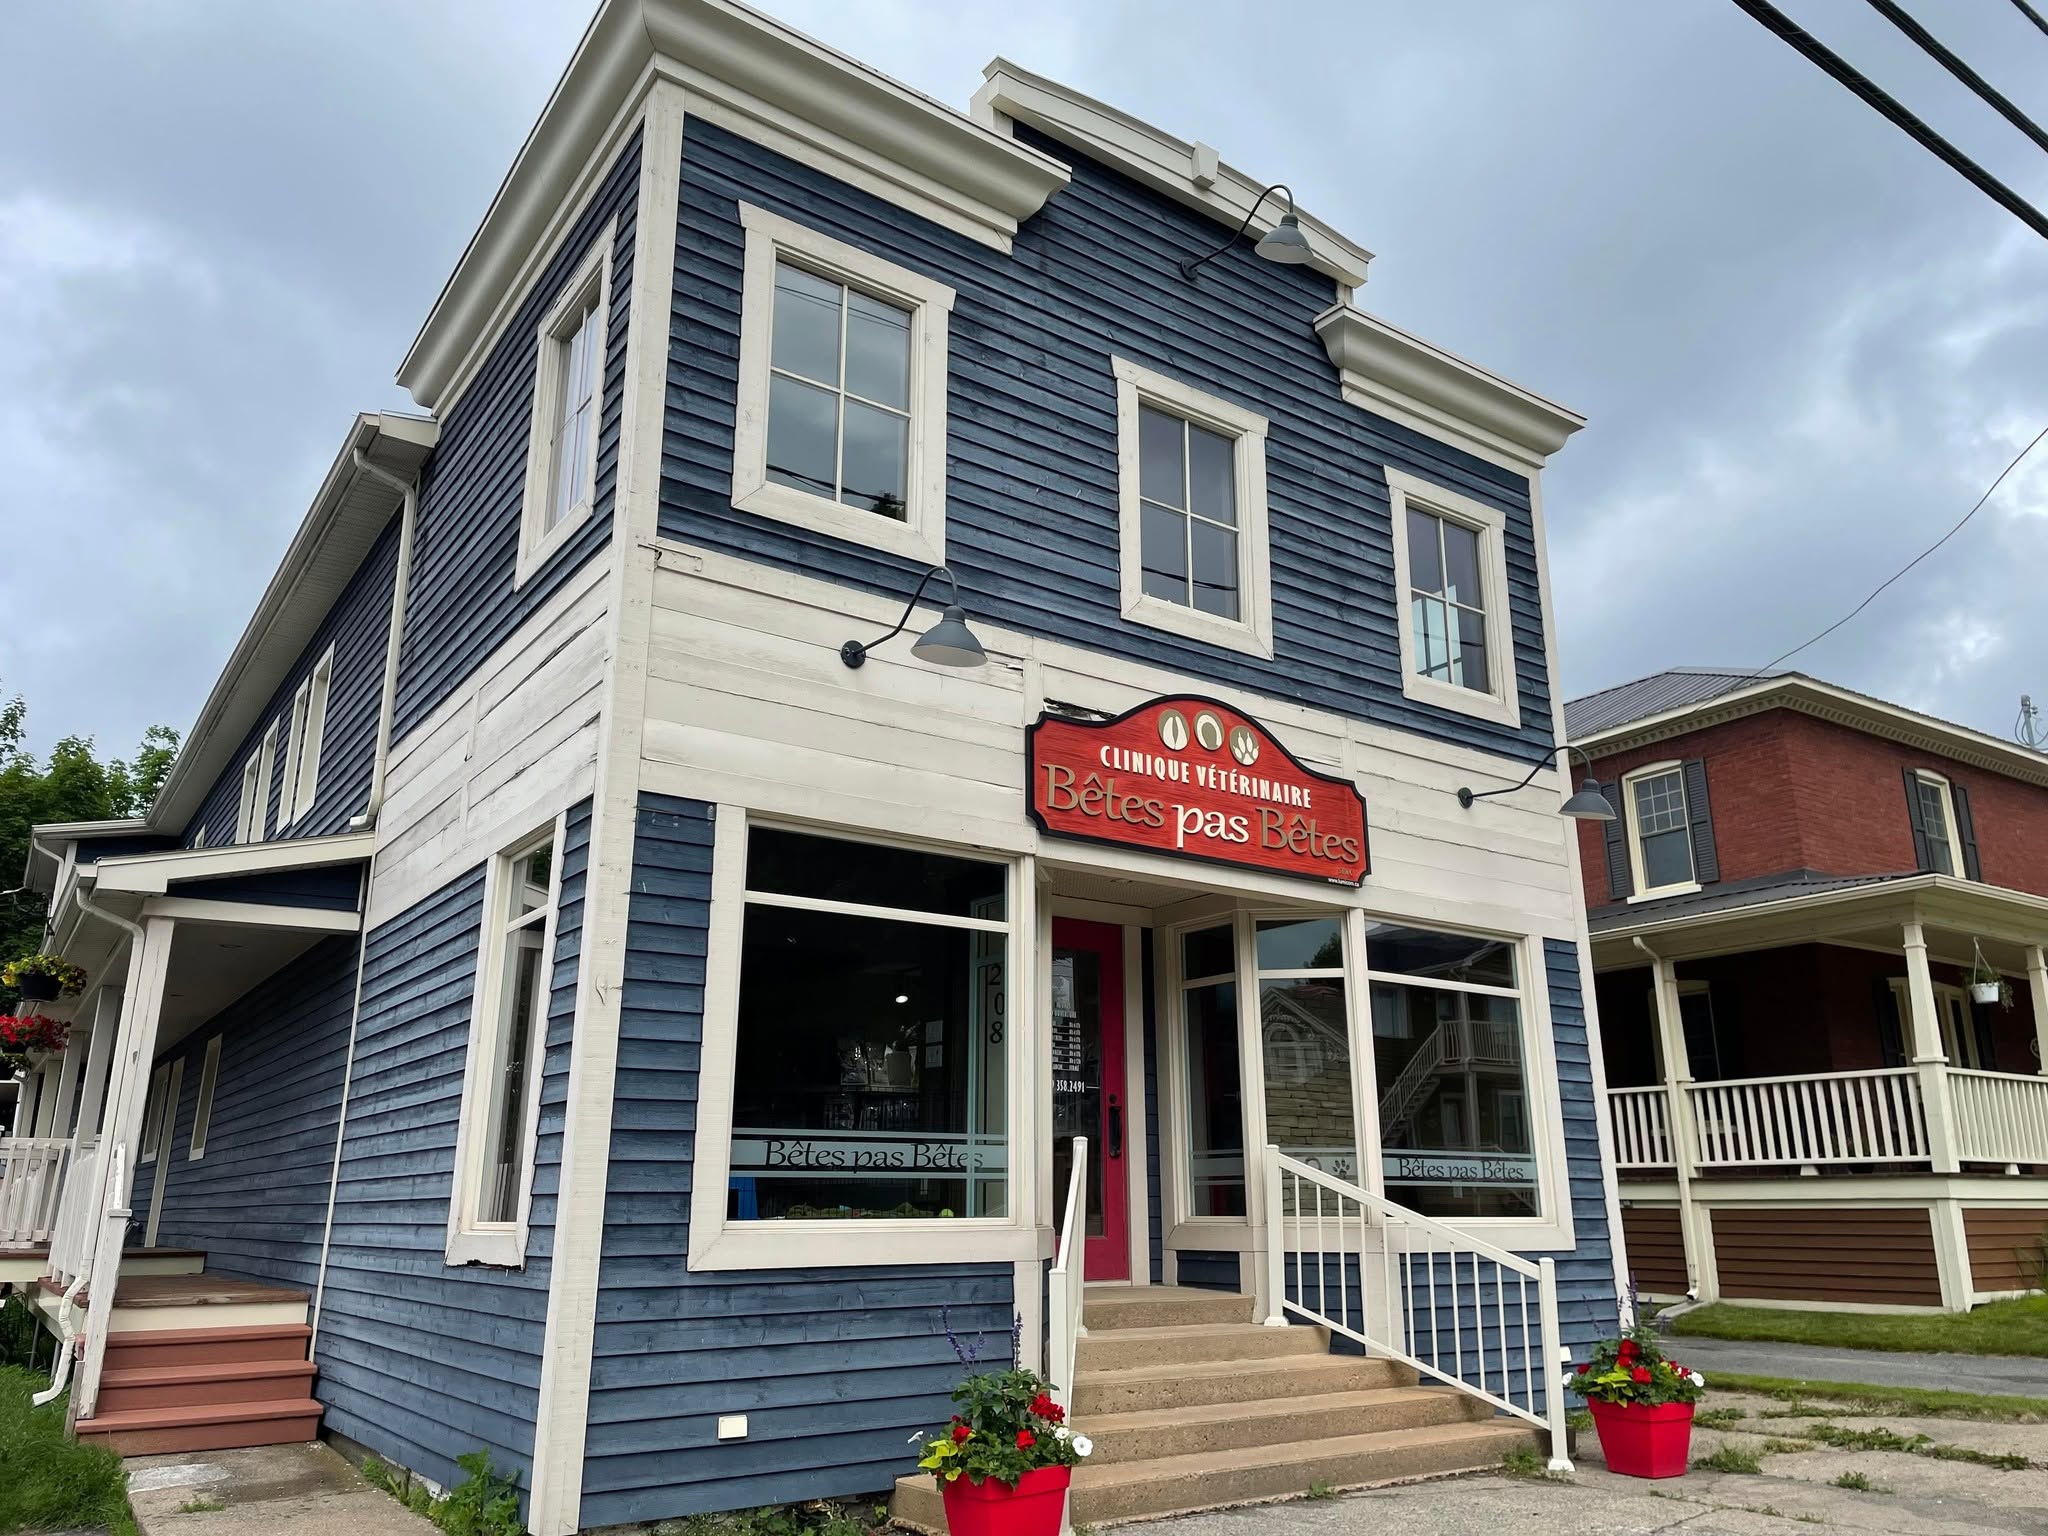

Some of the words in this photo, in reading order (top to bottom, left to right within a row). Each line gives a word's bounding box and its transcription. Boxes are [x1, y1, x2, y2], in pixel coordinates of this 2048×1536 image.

[1100, 745, 1190, 784] CLINIQUE
[1195, 766, 1312, 809] VÉTÉRINAIRE
[1041, 763, 1165, 828] Bêtes
[1171, 804, 1250, 848] pas
[1256, 807, 1360, 863] Bêtes
[1056, 1079, 1085, 1093] 358.2491
[763, 1138, 846, 1168] Bêtes
[853, 1150, 905, 1174] pas
[910, 1142, 983, 1169] Bêtes
[1397, 1157, 1445, 1180] Bêtes
[1446, 1165, 1478, 1184] pas
[1479, 1160, 1525, 1181] Bêtes
